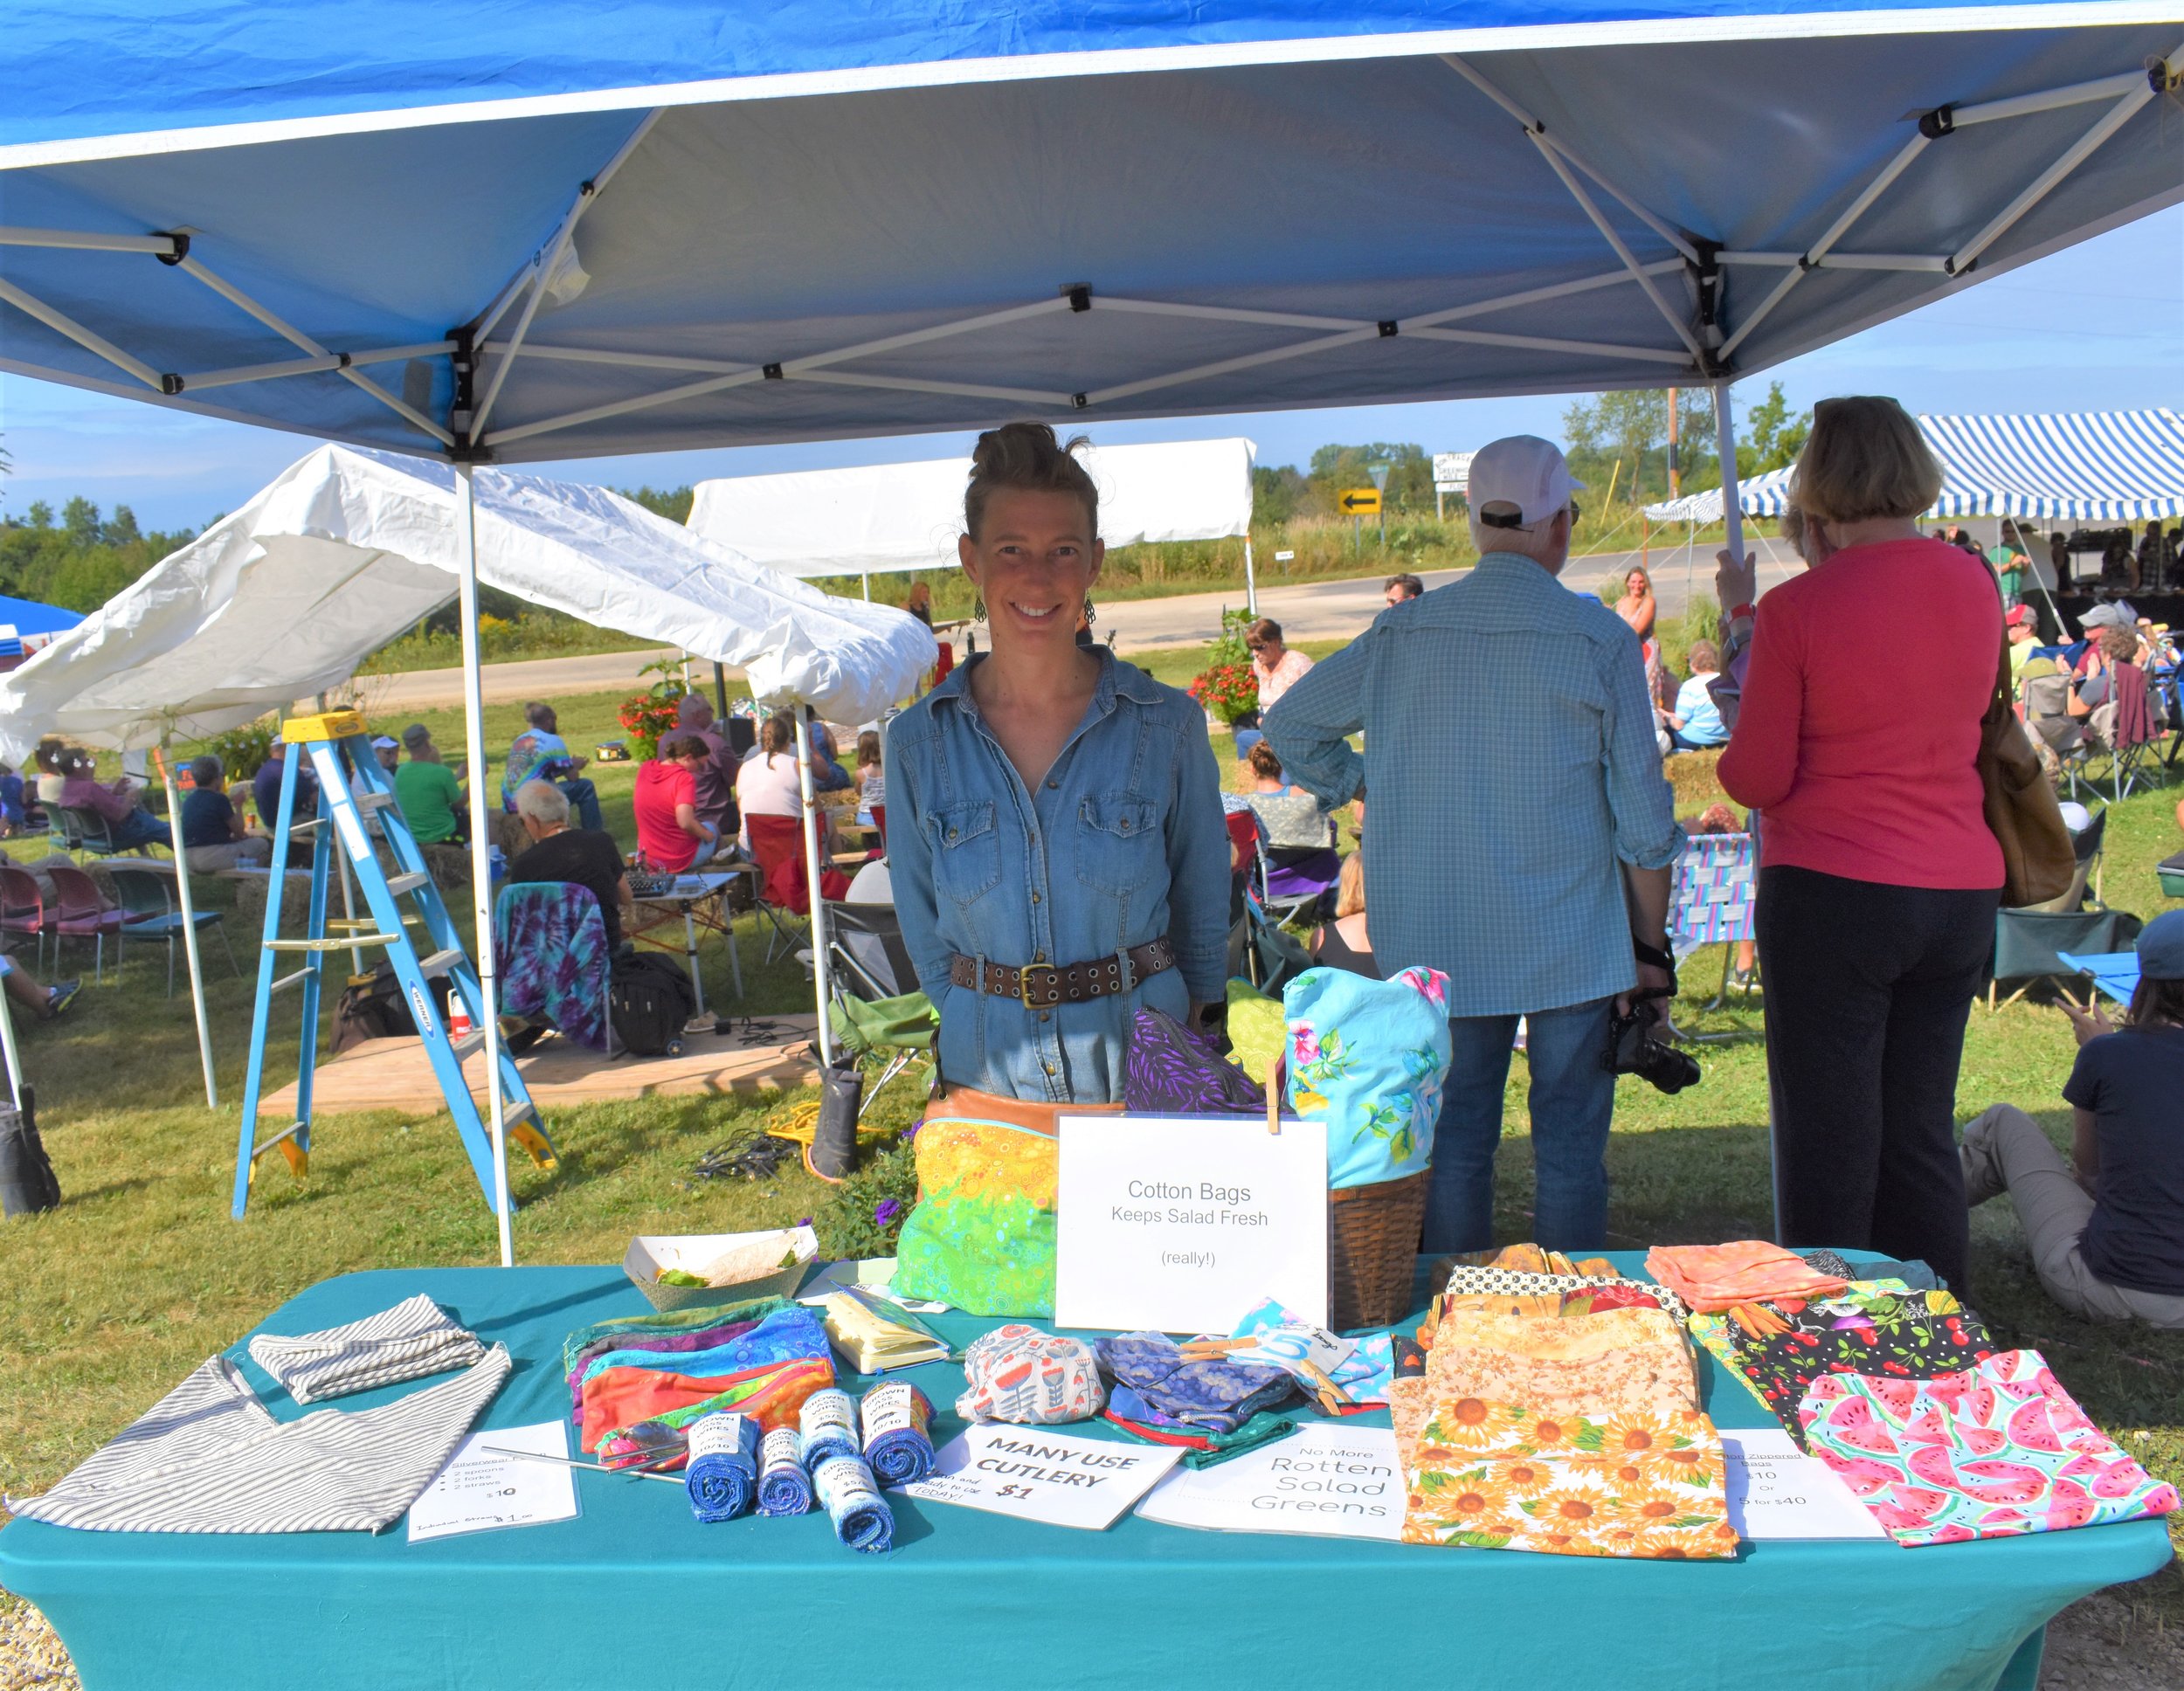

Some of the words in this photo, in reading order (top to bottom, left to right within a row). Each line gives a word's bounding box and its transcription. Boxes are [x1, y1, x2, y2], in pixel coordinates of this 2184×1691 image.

[412, 991, 432, 1028] WERNER
[1128, 1180, 1192, 1200] Cotton
[1199, 1182, 1251, 1204] Bags
[1112, 1206, 1162, 1225] Keeps
[1167, 1208, 1214, 1225] Salad
[1220, 1210, 1268, 1225] Fresh
[1161, 1251, 1216, 1268] (really!)
[986, 1437, 1082, 1462] MANY
[1079, 1452, 1140, 1470] USE
[1299, 1447, 1323, 1457] No
[1330, 1448, 1374, 1459] More
[465, 1467, 504, 1475] spoons
[976, 1458, 1109, 1488] CUTLERY
[1270, 1458, 1393, 1477] Rotten
[1746, 1471, 1777, 1480] $10
[465, 1480, 501, 1488] straws
[923, 1480, 946, 1490] eady
[995, 1483, 1034, 1501] $1
[1275, 1476, 1386, 1496] Salad
[1251, 1495, 1387, 1517] Greens
[1738, 1496, 1751, 1505] 5
[1775, 1496, 1807, 1506] $40
